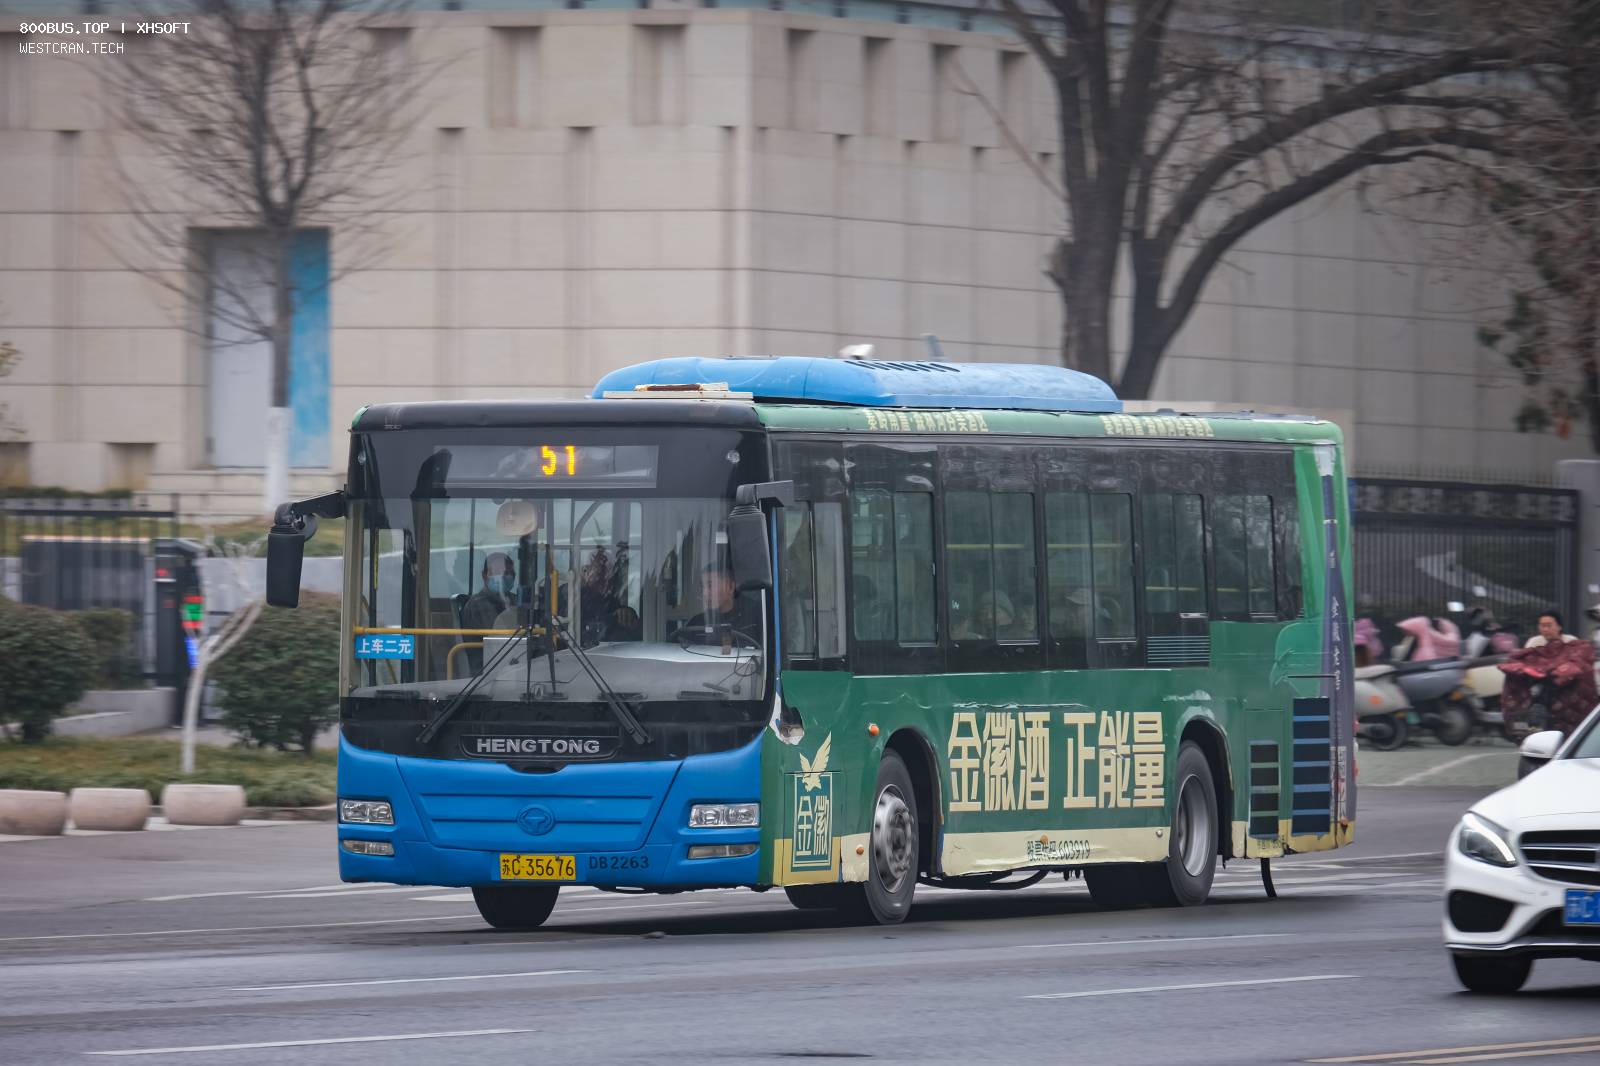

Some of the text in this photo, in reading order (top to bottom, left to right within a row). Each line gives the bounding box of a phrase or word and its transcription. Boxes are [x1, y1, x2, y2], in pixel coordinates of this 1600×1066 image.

[541, 445, 576, 475] 51
[357, 638, 412, 654] 上车二元
[477, 738, 600, 753] HENGTONG
[948, 710, 1166, 812] 金徽酒 正能量
